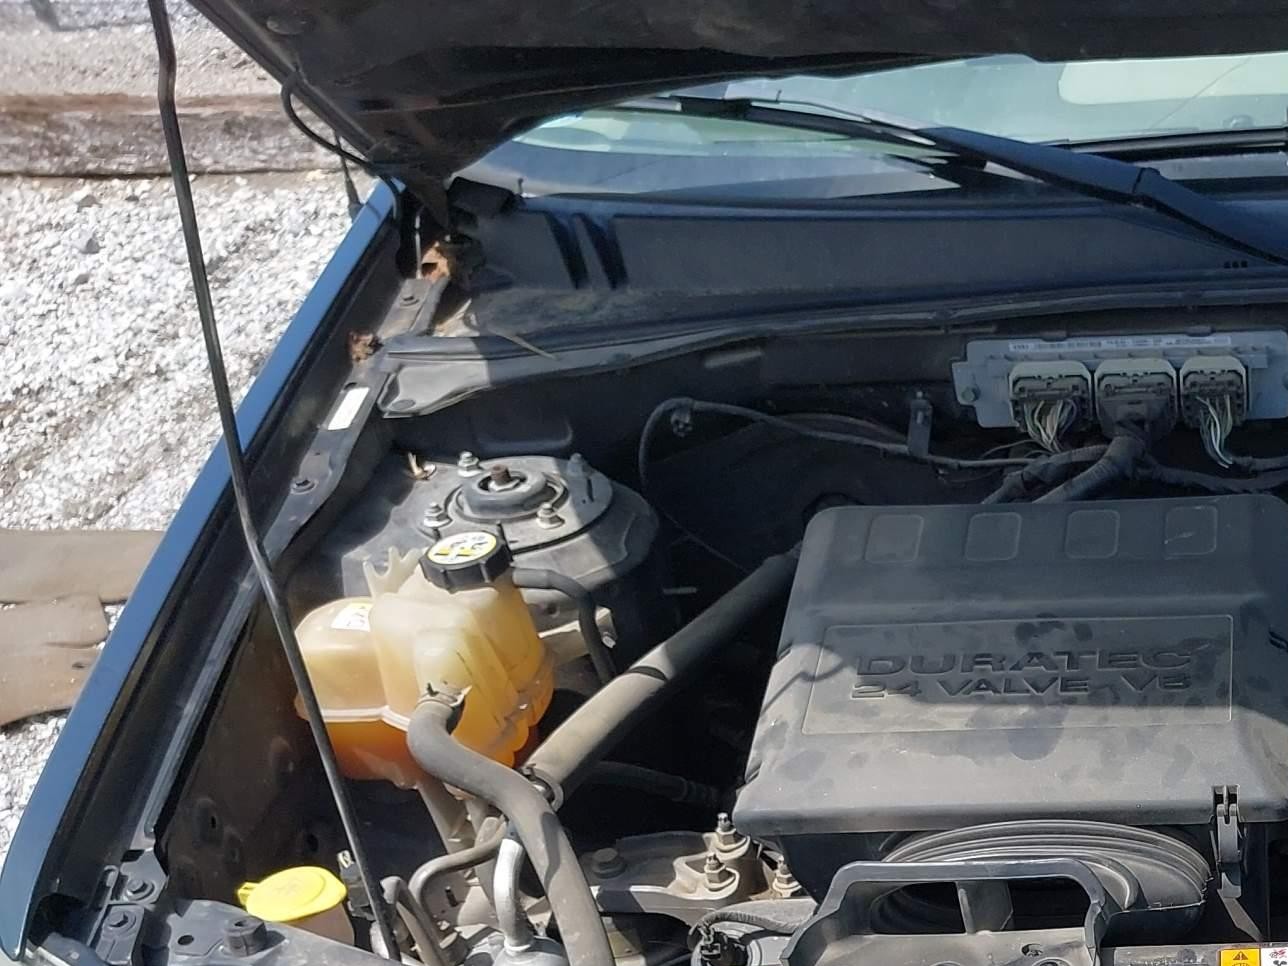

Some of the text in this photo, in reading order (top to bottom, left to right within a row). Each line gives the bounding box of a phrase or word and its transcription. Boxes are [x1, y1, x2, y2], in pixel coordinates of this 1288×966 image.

[856, 651, 1191, 676] DURATEC
[851, 671, 1191, 700] 24 VALVE V6
